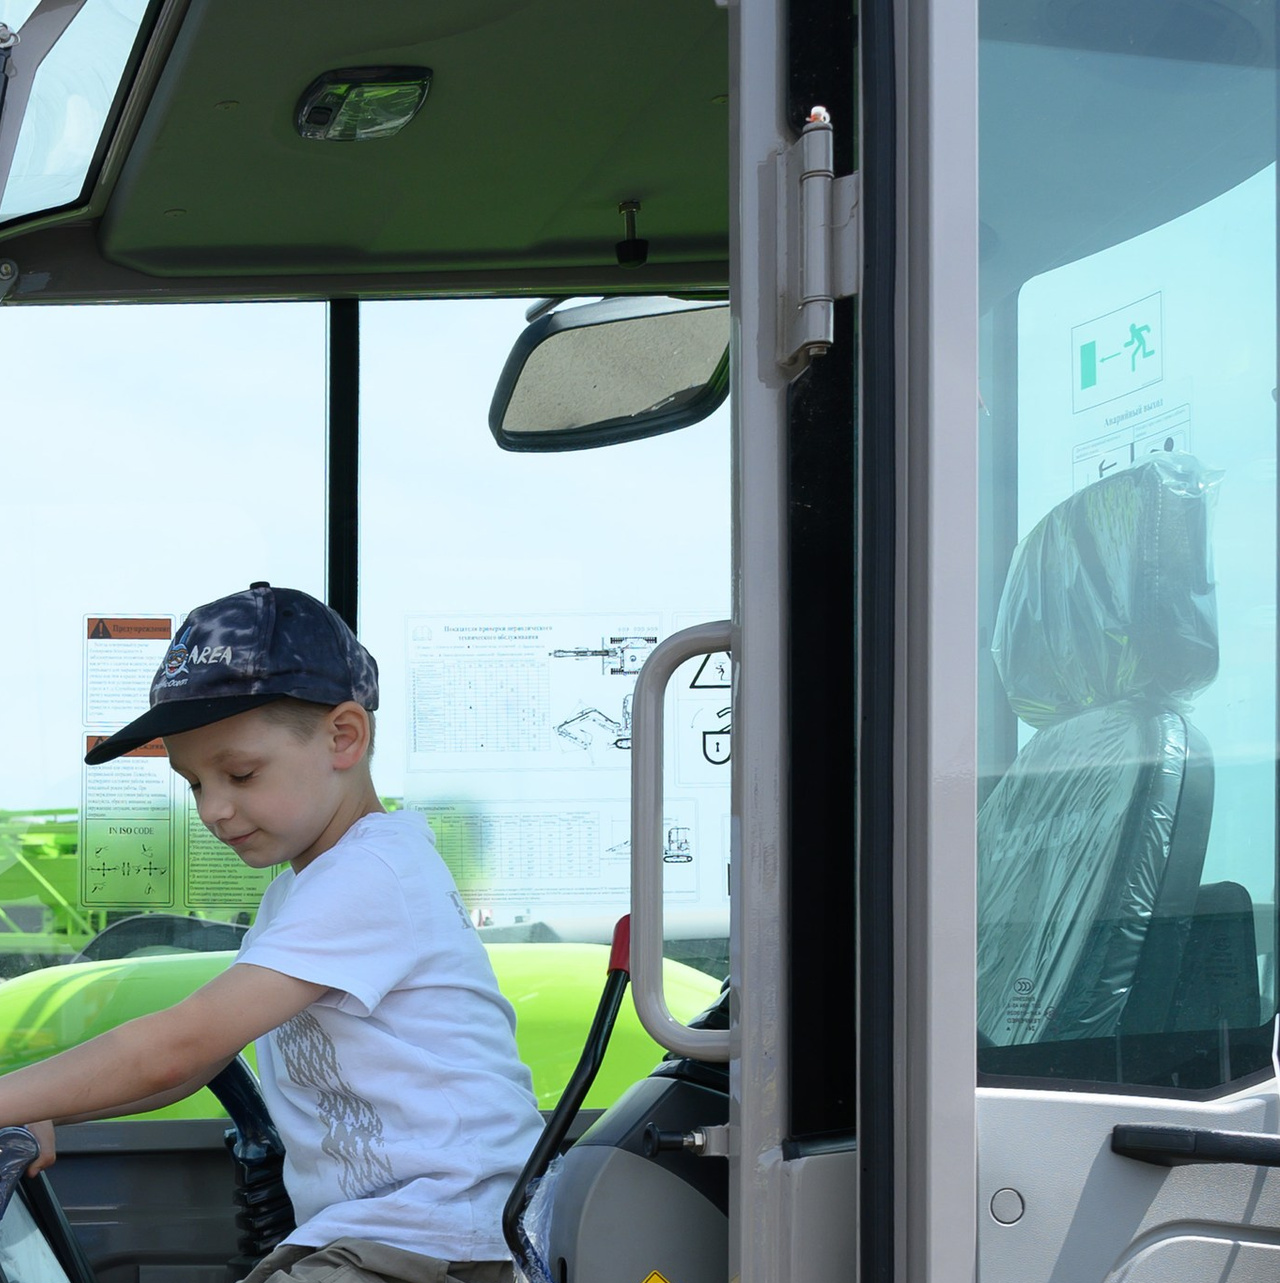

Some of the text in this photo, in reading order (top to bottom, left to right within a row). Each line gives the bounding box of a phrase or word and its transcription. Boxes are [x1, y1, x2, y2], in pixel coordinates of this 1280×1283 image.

[1104, 405, 1142, 427] Аварийный
[1144, 398, 1163, 414] выход
[187, 644, 232, 666] AREA
